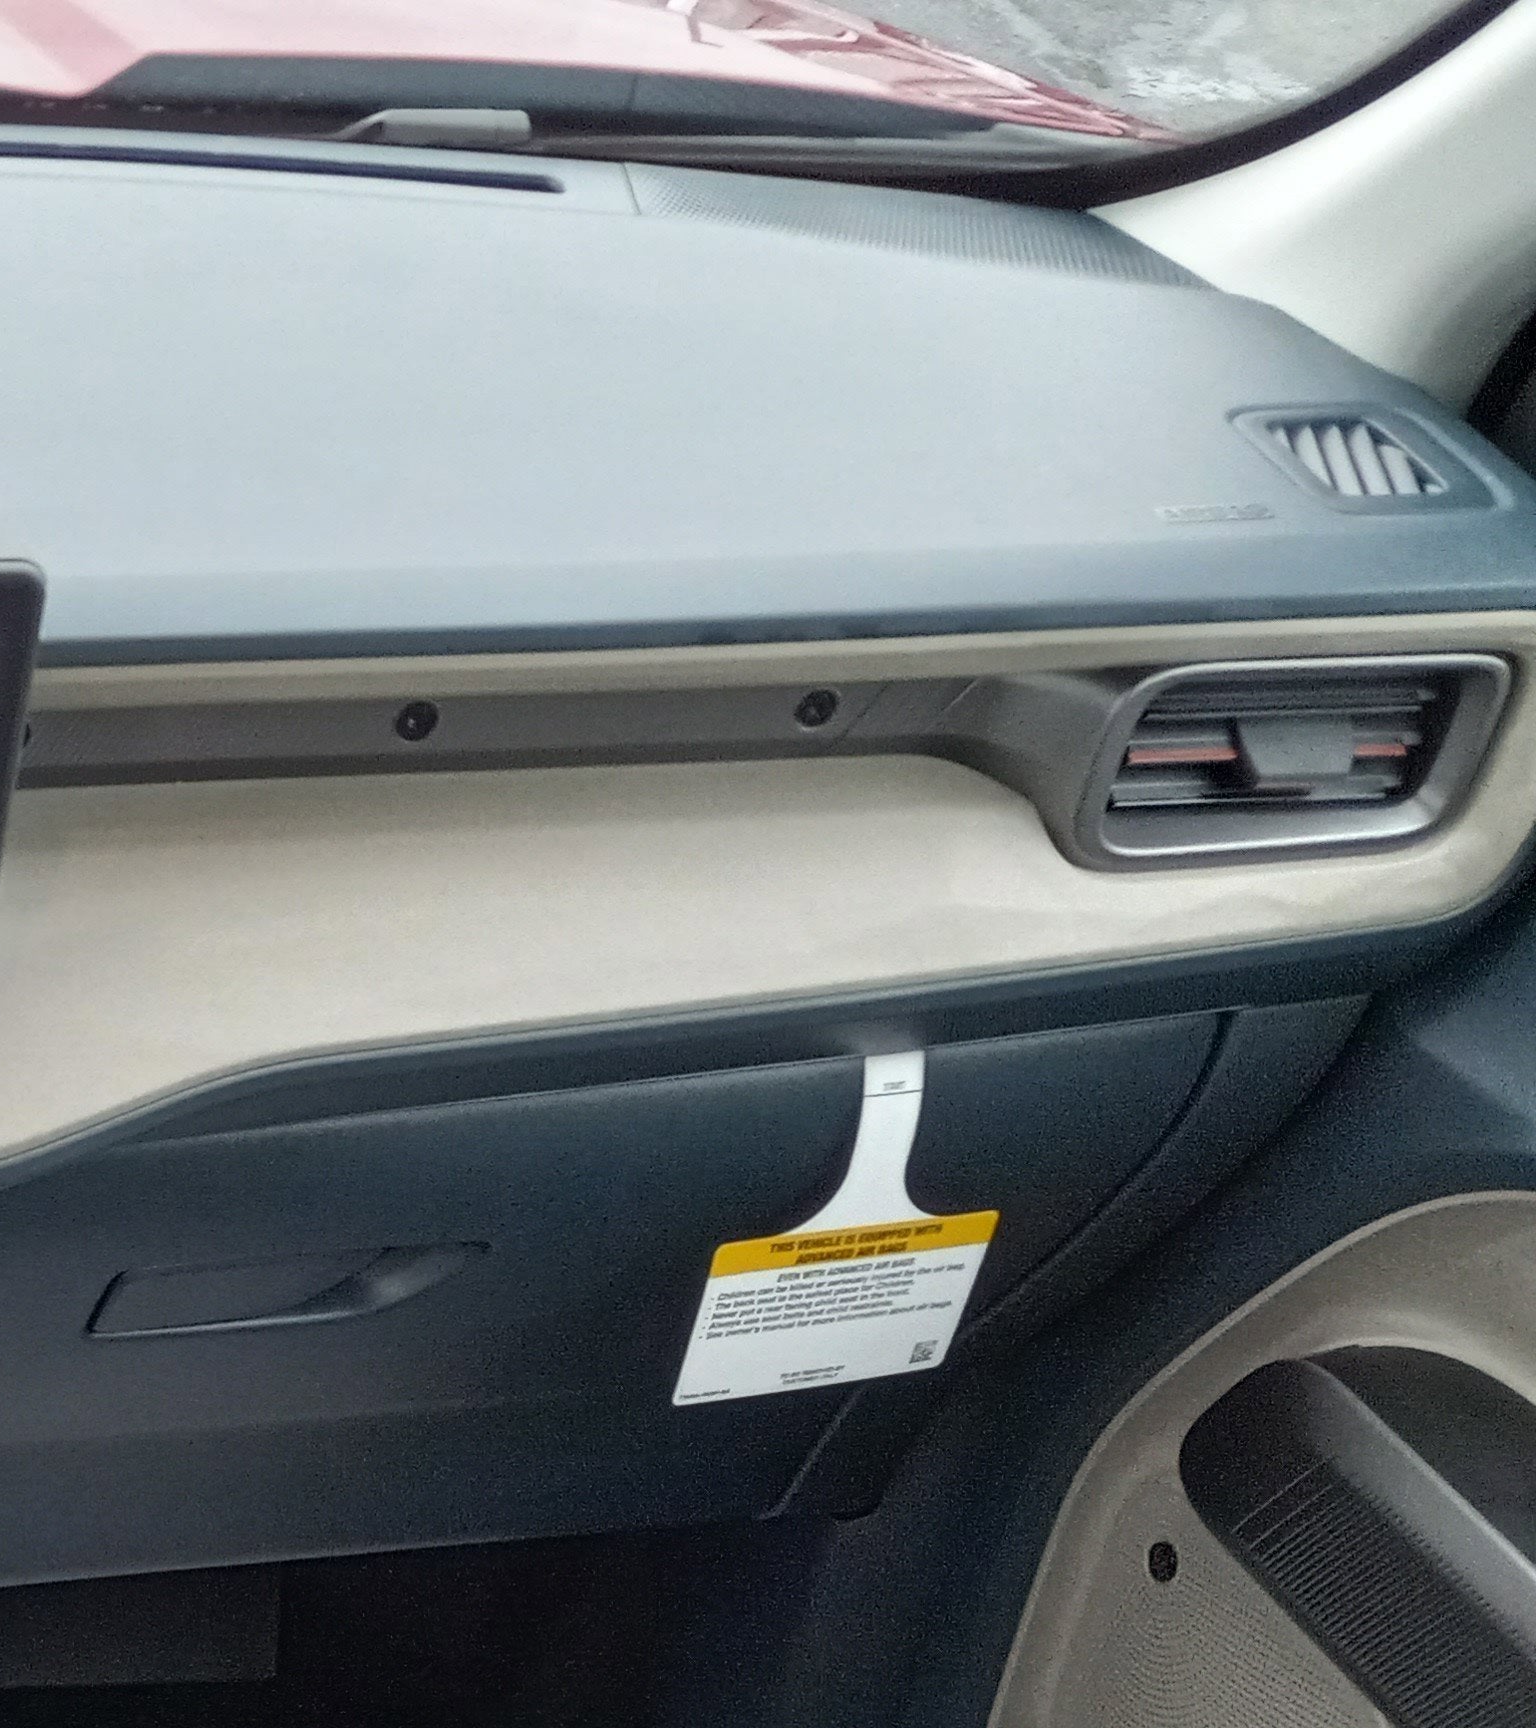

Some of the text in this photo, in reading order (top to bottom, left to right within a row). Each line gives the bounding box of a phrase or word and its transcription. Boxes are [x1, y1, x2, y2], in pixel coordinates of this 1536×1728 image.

[796, 1236, 842, 1251] VEHICLE
[858, 1227, 912, 1243] EQUIPPED
[914, 1223, 943, 1236] WITH
[794, 1247, 856, 1264] ADVANCED
